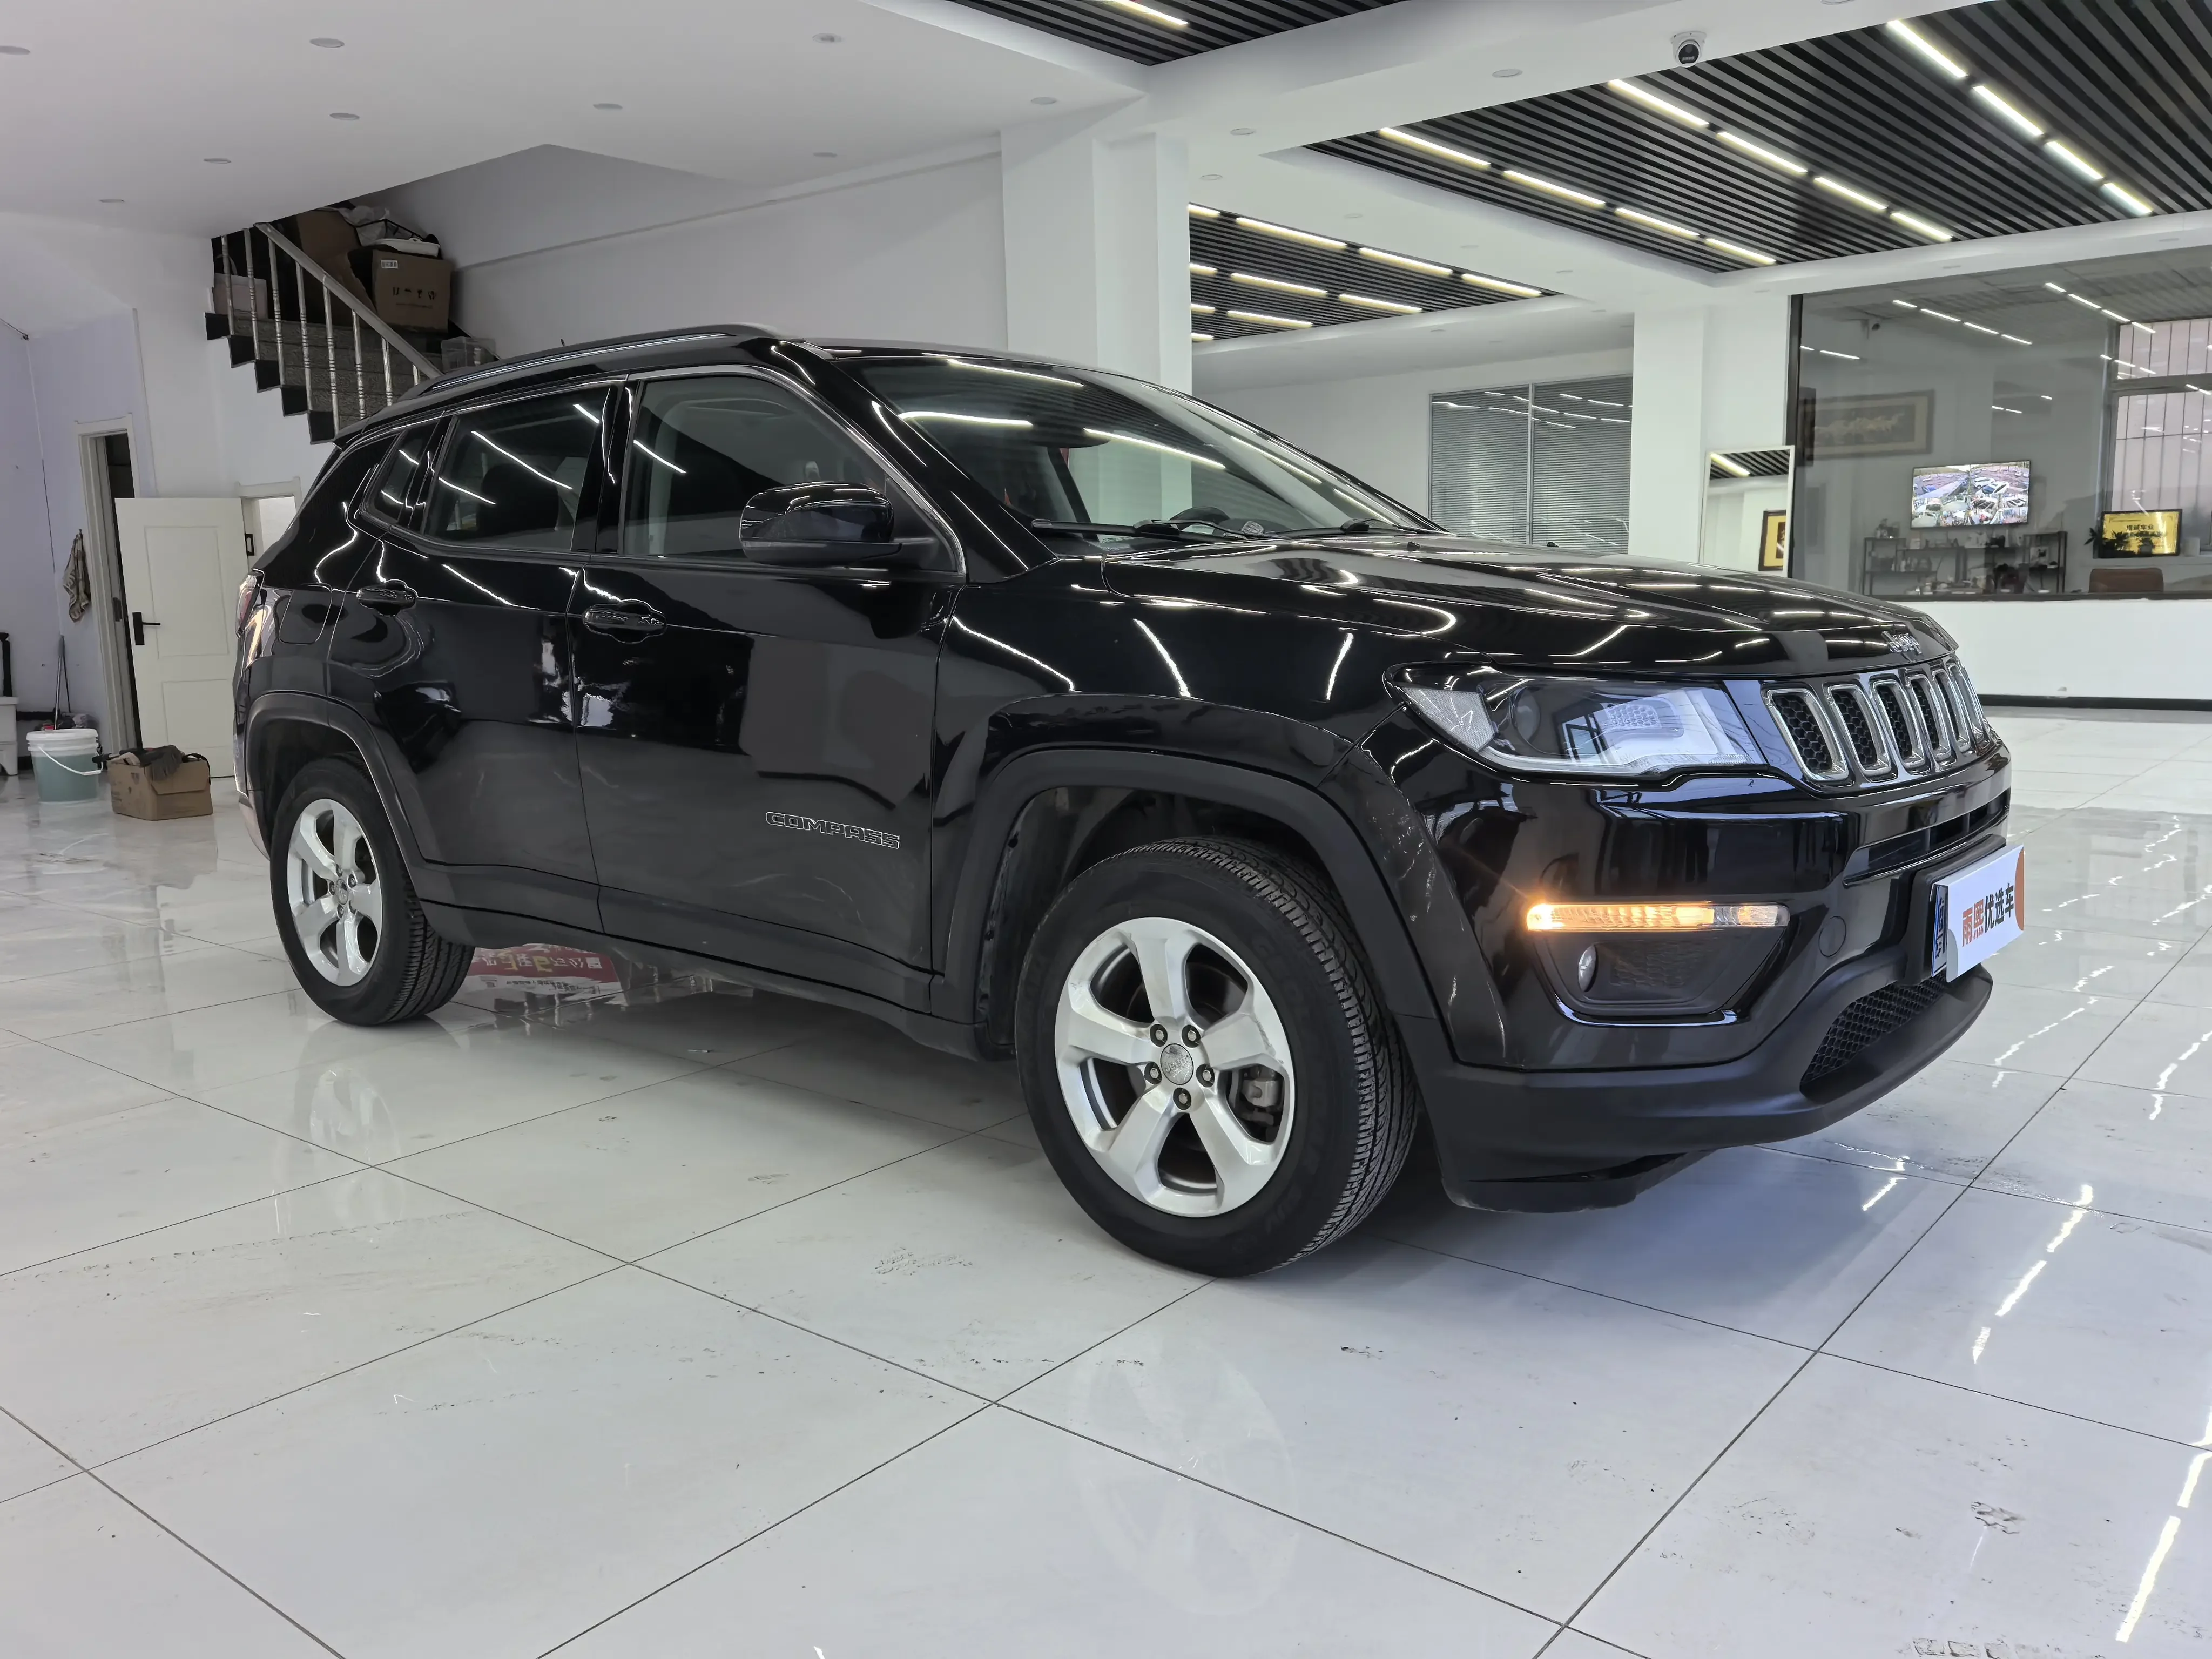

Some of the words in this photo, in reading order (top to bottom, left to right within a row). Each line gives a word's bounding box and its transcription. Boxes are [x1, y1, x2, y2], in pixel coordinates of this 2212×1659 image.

[765, 811, 901, 850] COMPASS
[1961, 882, 2014, 947] 雨熙优选车
[1164, 1056, 1188, 1073] Jeep
